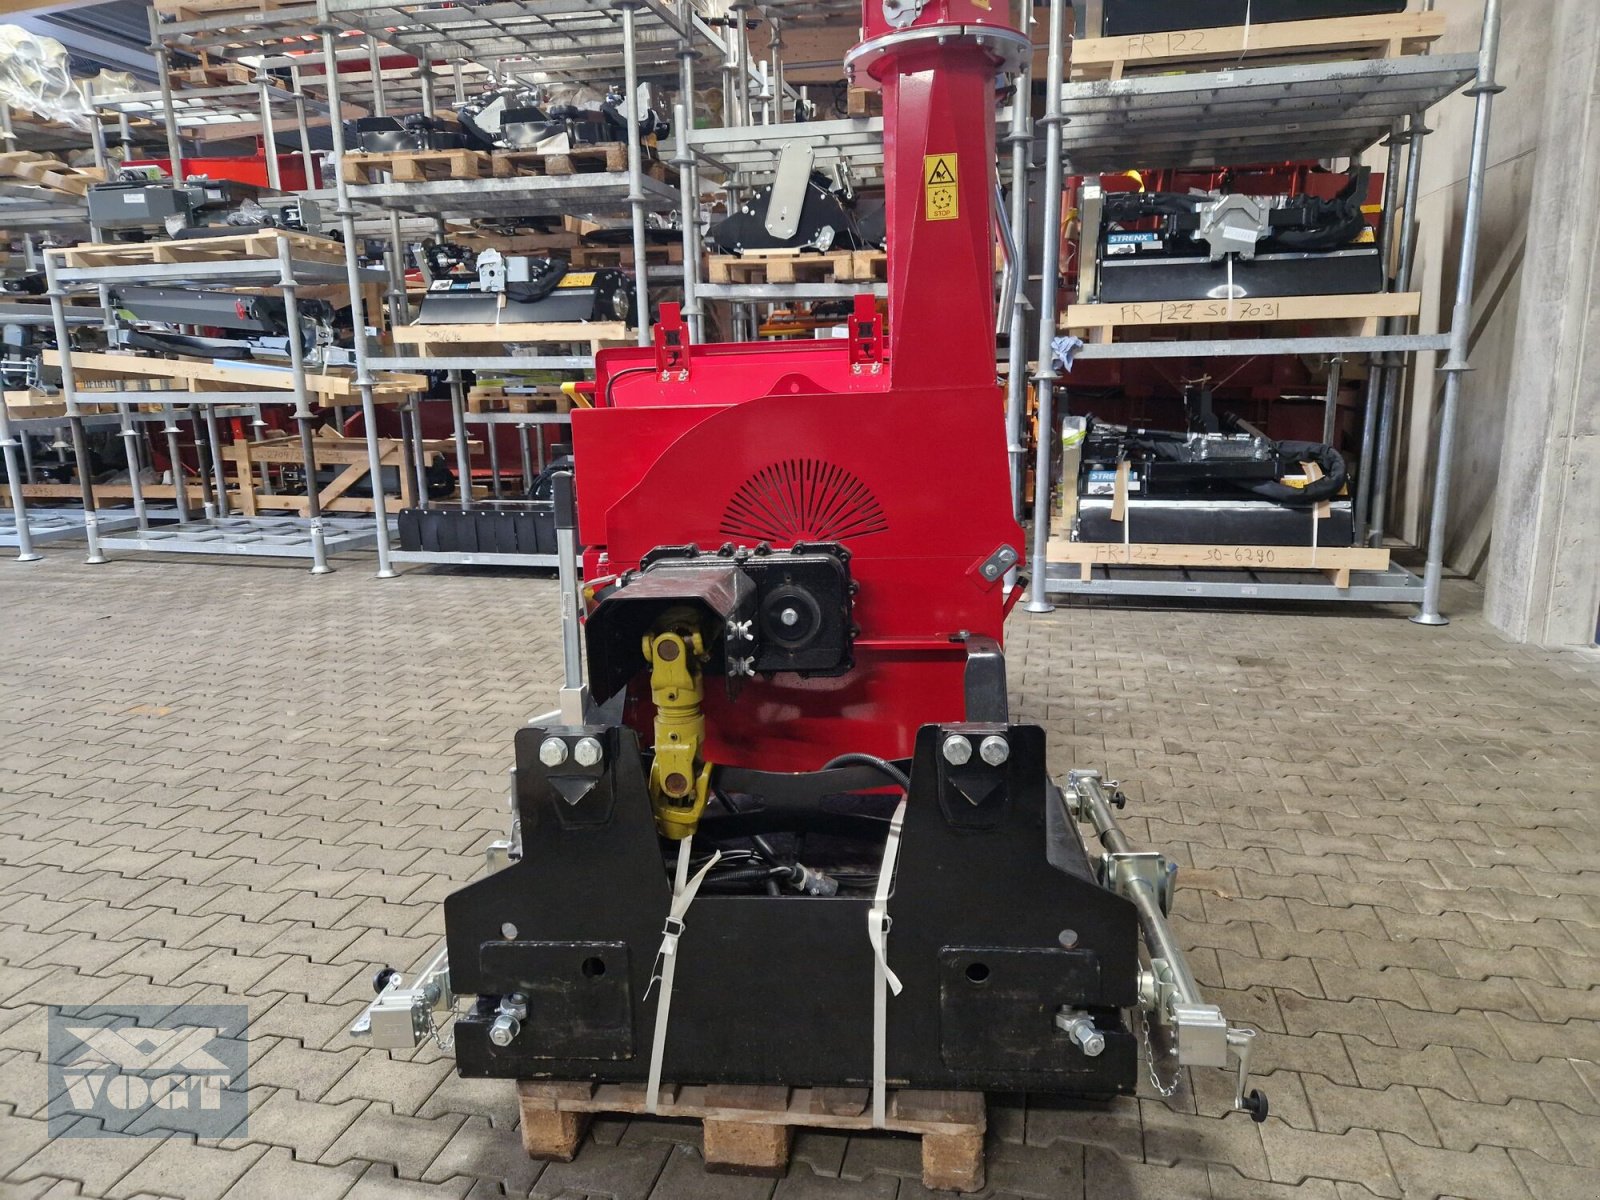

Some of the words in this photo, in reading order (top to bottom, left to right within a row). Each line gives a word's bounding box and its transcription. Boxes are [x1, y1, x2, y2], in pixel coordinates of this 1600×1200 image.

[1128, 34, 1154, 57] FR
[1167, 32, 1207, 56] 122
[1110, 234, 1148, 242] STRENX
